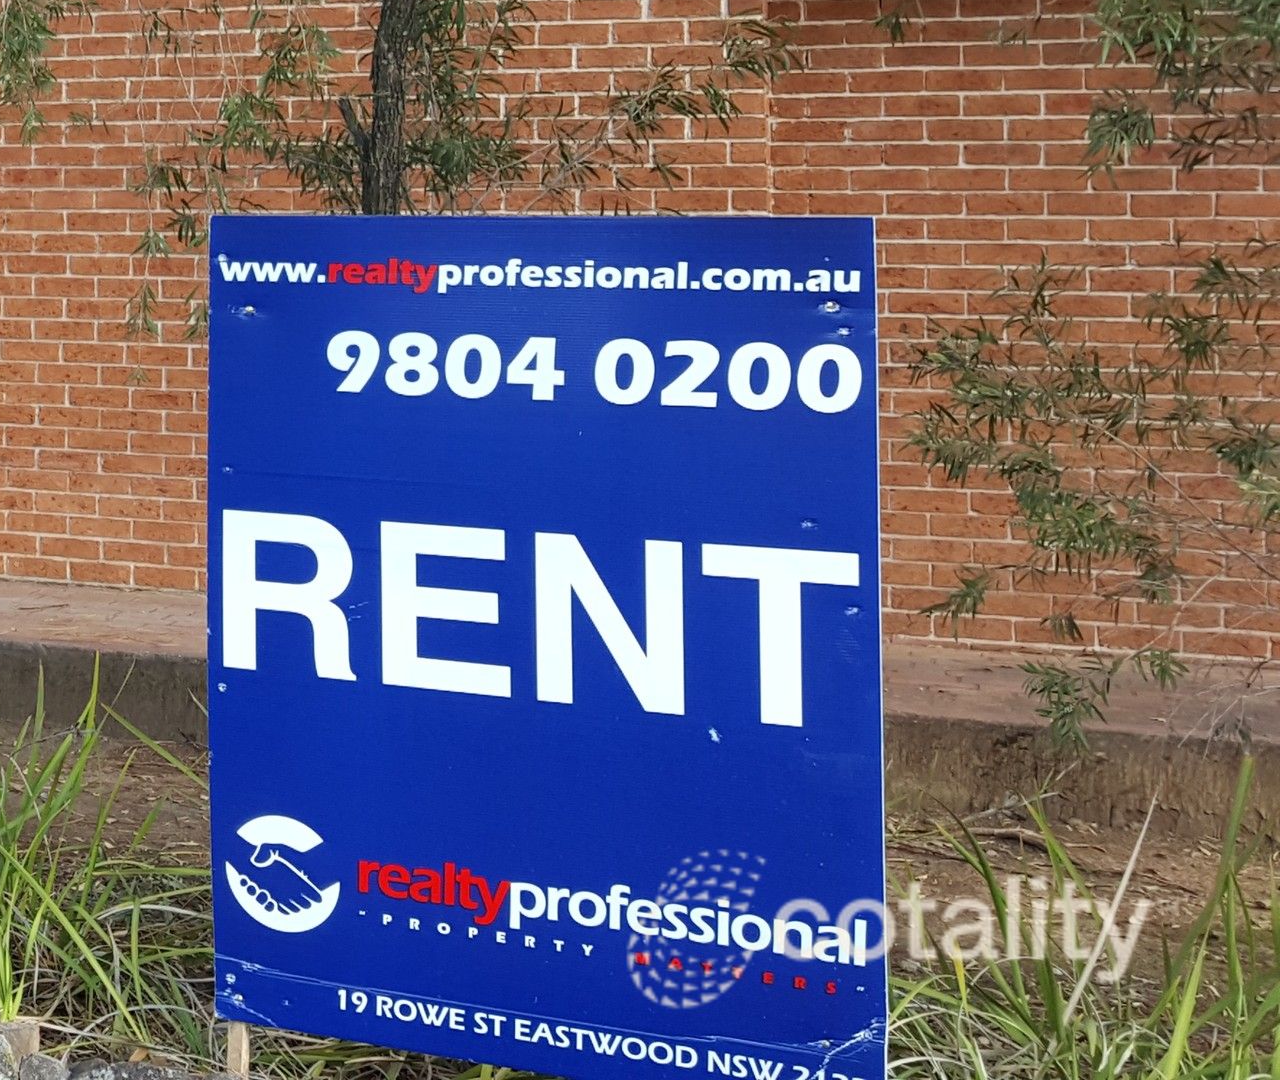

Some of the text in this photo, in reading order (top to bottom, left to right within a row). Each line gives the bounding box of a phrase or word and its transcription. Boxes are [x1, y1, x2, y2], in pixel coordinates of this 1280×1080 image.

[219, 256, 862, 295] www.realtyprofessional.com.au
[327, 330, 863, 414] 9804 0200
[222, 509, 861, 728] RENT
[357, 859, 868, 968] realtyprofessional
[337, 988, 369, 1014] 19
[375, 994, 466, 1031] ROWE
[473, 1011, 507, 1037] ST
[514, 1017, 699, 1069] EASTWOOD
[706, 1049, 785, 1080] NSW
